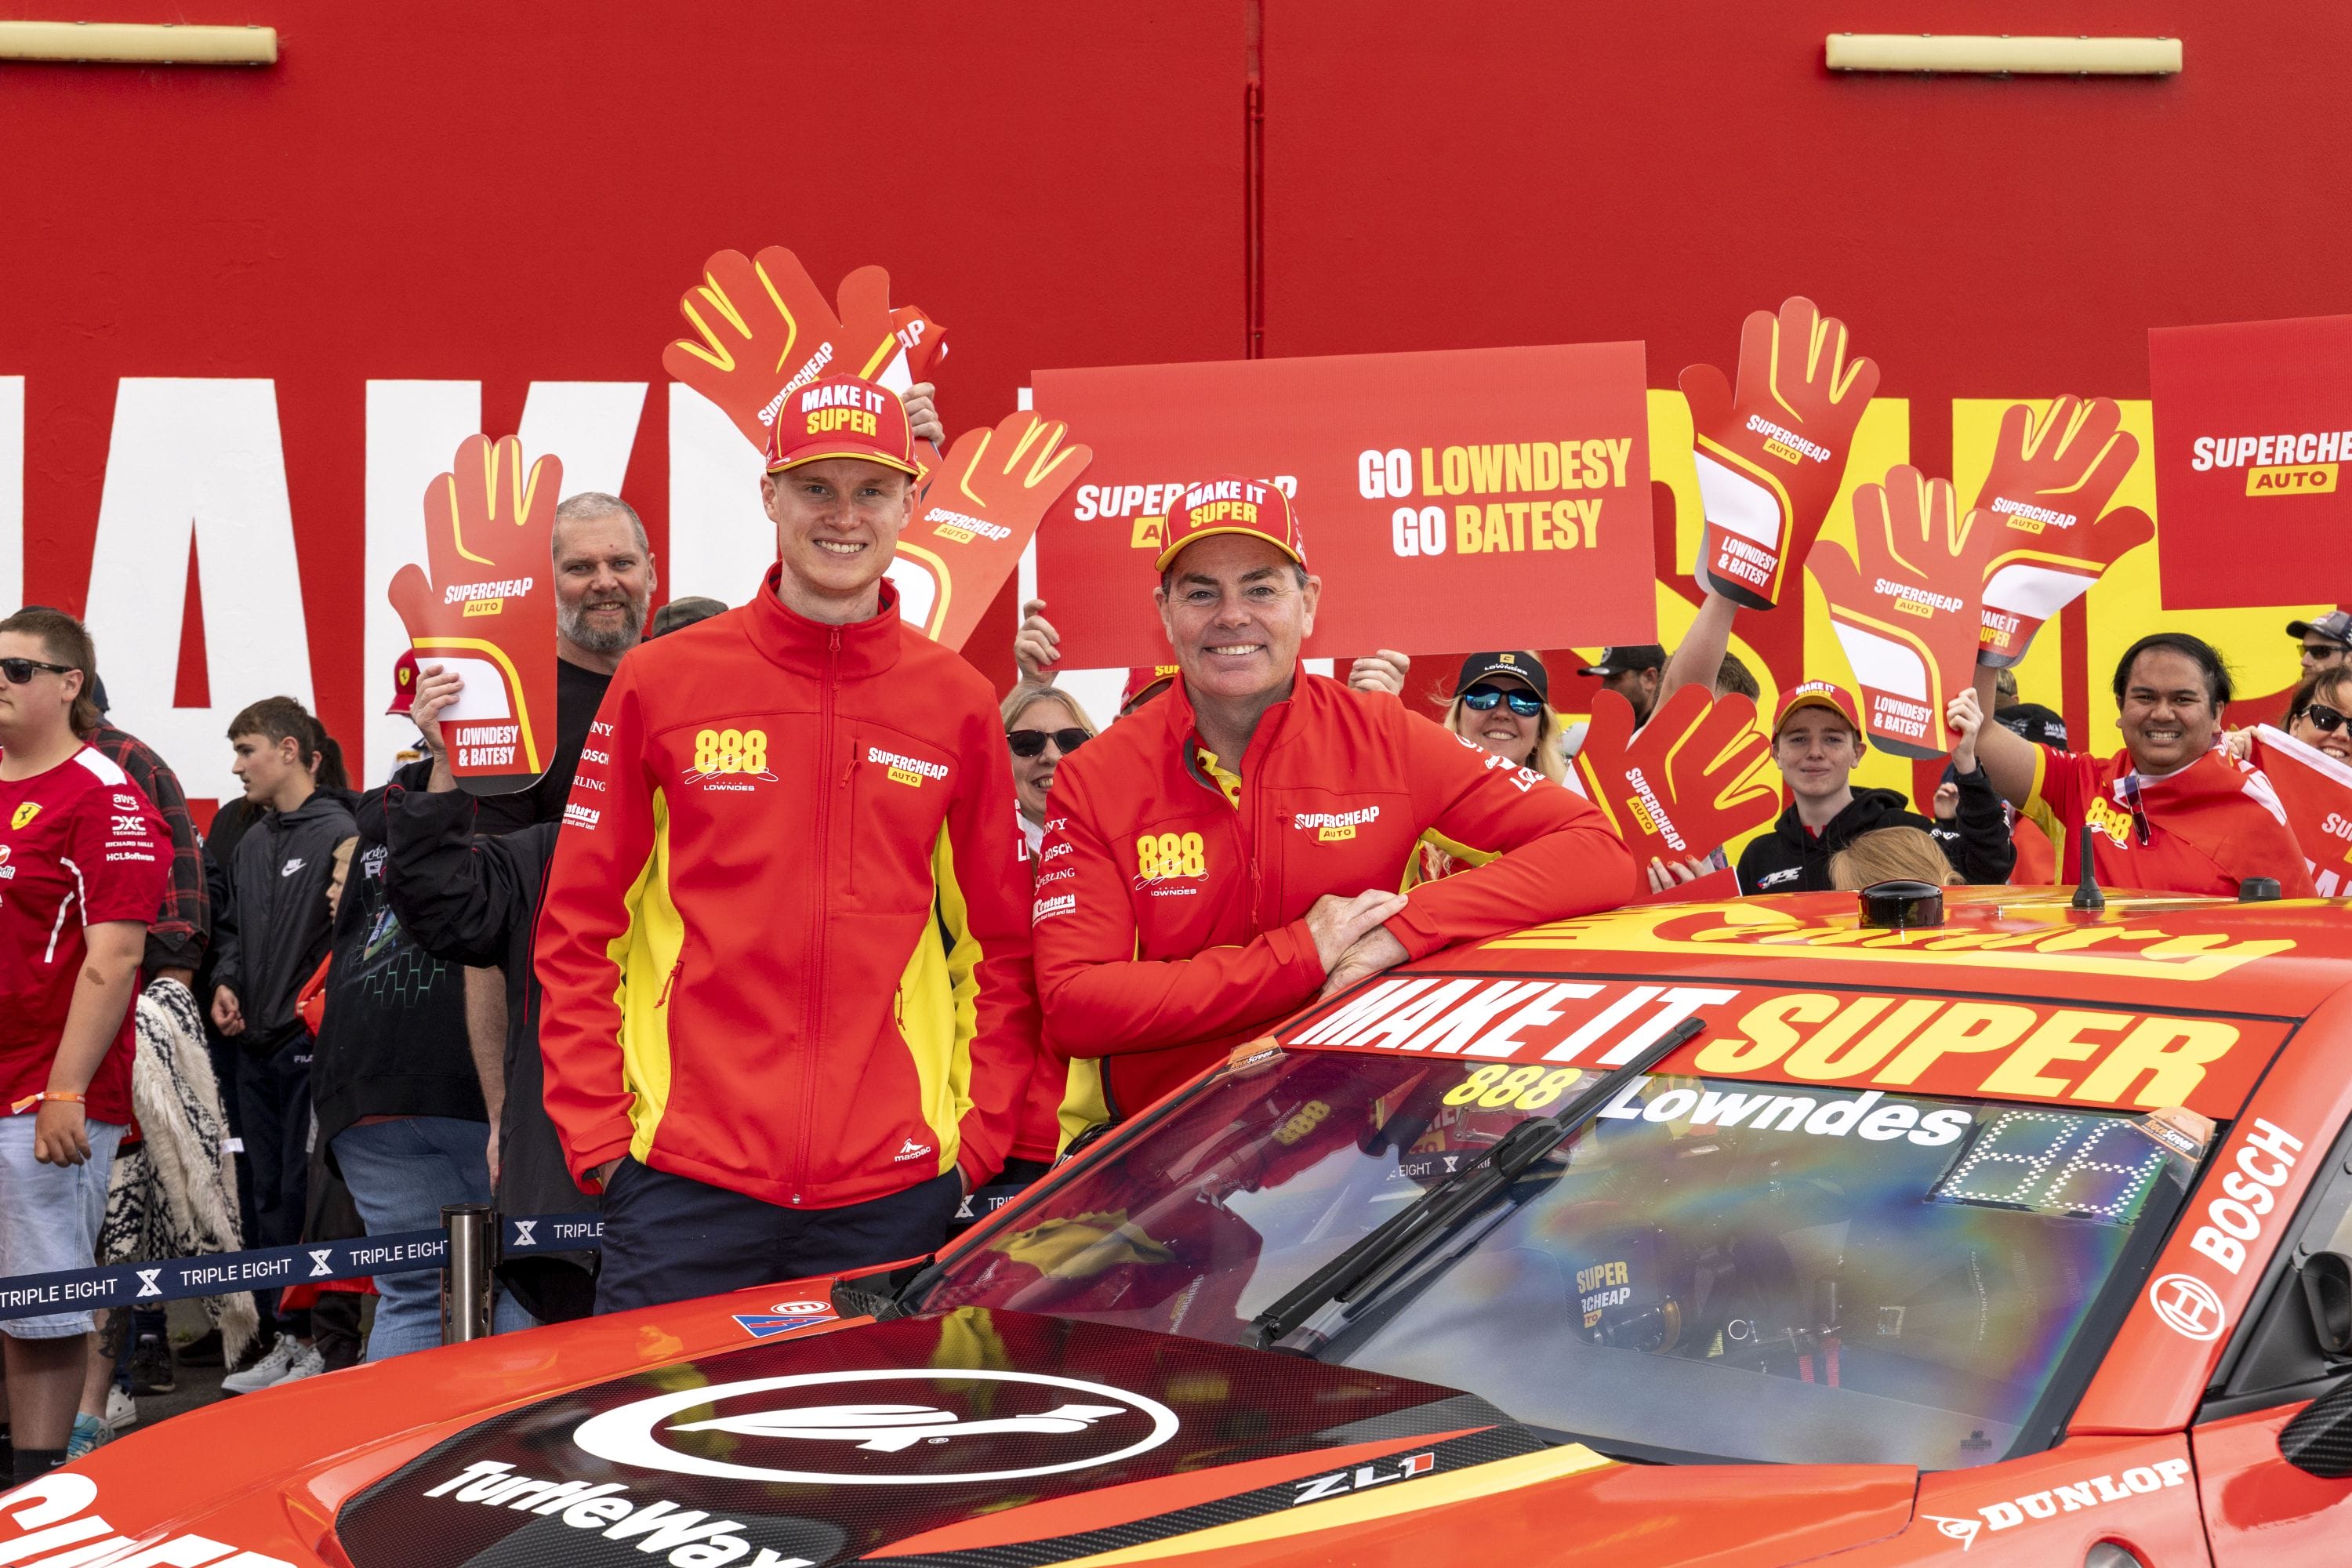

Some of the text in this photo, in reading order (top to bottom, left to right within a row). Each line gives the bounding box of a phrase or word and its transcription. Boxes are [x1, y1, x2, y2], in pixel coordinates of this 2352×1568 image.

[801, 384, 885, 414] MAKE IT
[807, 408, 877, 437] SUPER
[1746, 414, 1831, 464] SUPERCHEAP
[1768, 441, 1798, 460] AUTO
[2192, 430, 2352, 472] SUPERCHE
[1359, 437, 1633, 499] GO LOWNDESY
[2255, 471, 2328, 489] AUTO
[1074, 475, 1298, 521] SUPERP
[1185, 481, 1267, 510] MAKE IT
[924, 507, 1011, 542] SUPERCHEAP
[1190, 502, 1258, 528] SUPER
[1991, 497, 2077, 530] SUPERCHEAP
[2011, 517, 2040, 530] AUTO
[940, 527, 969, 541] AUTO
[1392, 499, 1603, 557] GO BATESY
[1721, 535, 1778, 574] LOWNDESY
[1718, 553, 1769, 588] & BATESY
[445, 577, 533, 604] SUPERCHEAP
[1875, 579, 1963, 613] SUPERCHEAP
[467, 601, 499, 613] AUTO
[1899, 601, 1929, 615] AUTO
[1980, 626, 2009, 648] UPER
[2007, 618, 2020, 634] IT
[1155, 664, 1180, 677] SUP
[1795, 681, 1824, 695] MAKE
[1825, 683, 1835, 693] IT
[1874, 695, 1933, 724] LOWNDESY
[456, 725, 519, 746] LOWNDESY
[590, 720, 613, 736] NY
[1873, 713, 1926, 739] & BATESY
[459, 746, 515, 766] & BATESY
[695, 729, 767, 775] 888
[868, 747, 949, 780] SUPERCHEAP
[574, 775, 606, 792] RLING
[892, 771, 918, 783] AUTO
[113, 793, 137, 805] aws
[564, 802, 601, 823] ntury
[1625, 768, 1686, 851] SUPERCHEAP
[111, 815, 147, 831] DXC
[1043, 818, 1067, 837] ONY
[1294, 806, 1380, 829] SUPERCHEAP
[1632, 802, 1652, 829] AUTO
[1044, 842, 1073, 862] BOSCH
[1137, 832, 1205, 880] 888
[1287, 978, 2241, 1109] MAKE IT SUPER
[1443, 1064, 1583, 1110] 888
[1596, 1076, 1973, 1146] Lowndes
[2144, 1120, 2194, 1151] RaceScreen
[895, 1146, 931, 1162] macpac
[1399, 1161, 1432, 1177] EIGHT
[2190, 1118, 2303, 1275] BOSCH
[554, 1222, 604, 1239] TRIPLE
[350, 1245, 404, 1266] TRIPLE
[180, 1258, 292, 1286] TRIPLE EIGHT
[1577, 1261, 1629, 1294] SUPER
[0, 1279, 118, 1308] TRIPLE EIGHT
[1294, 1452, 1435, 1506] ZL1
[1978, 1457, 2190, 1532] DUNLOP
